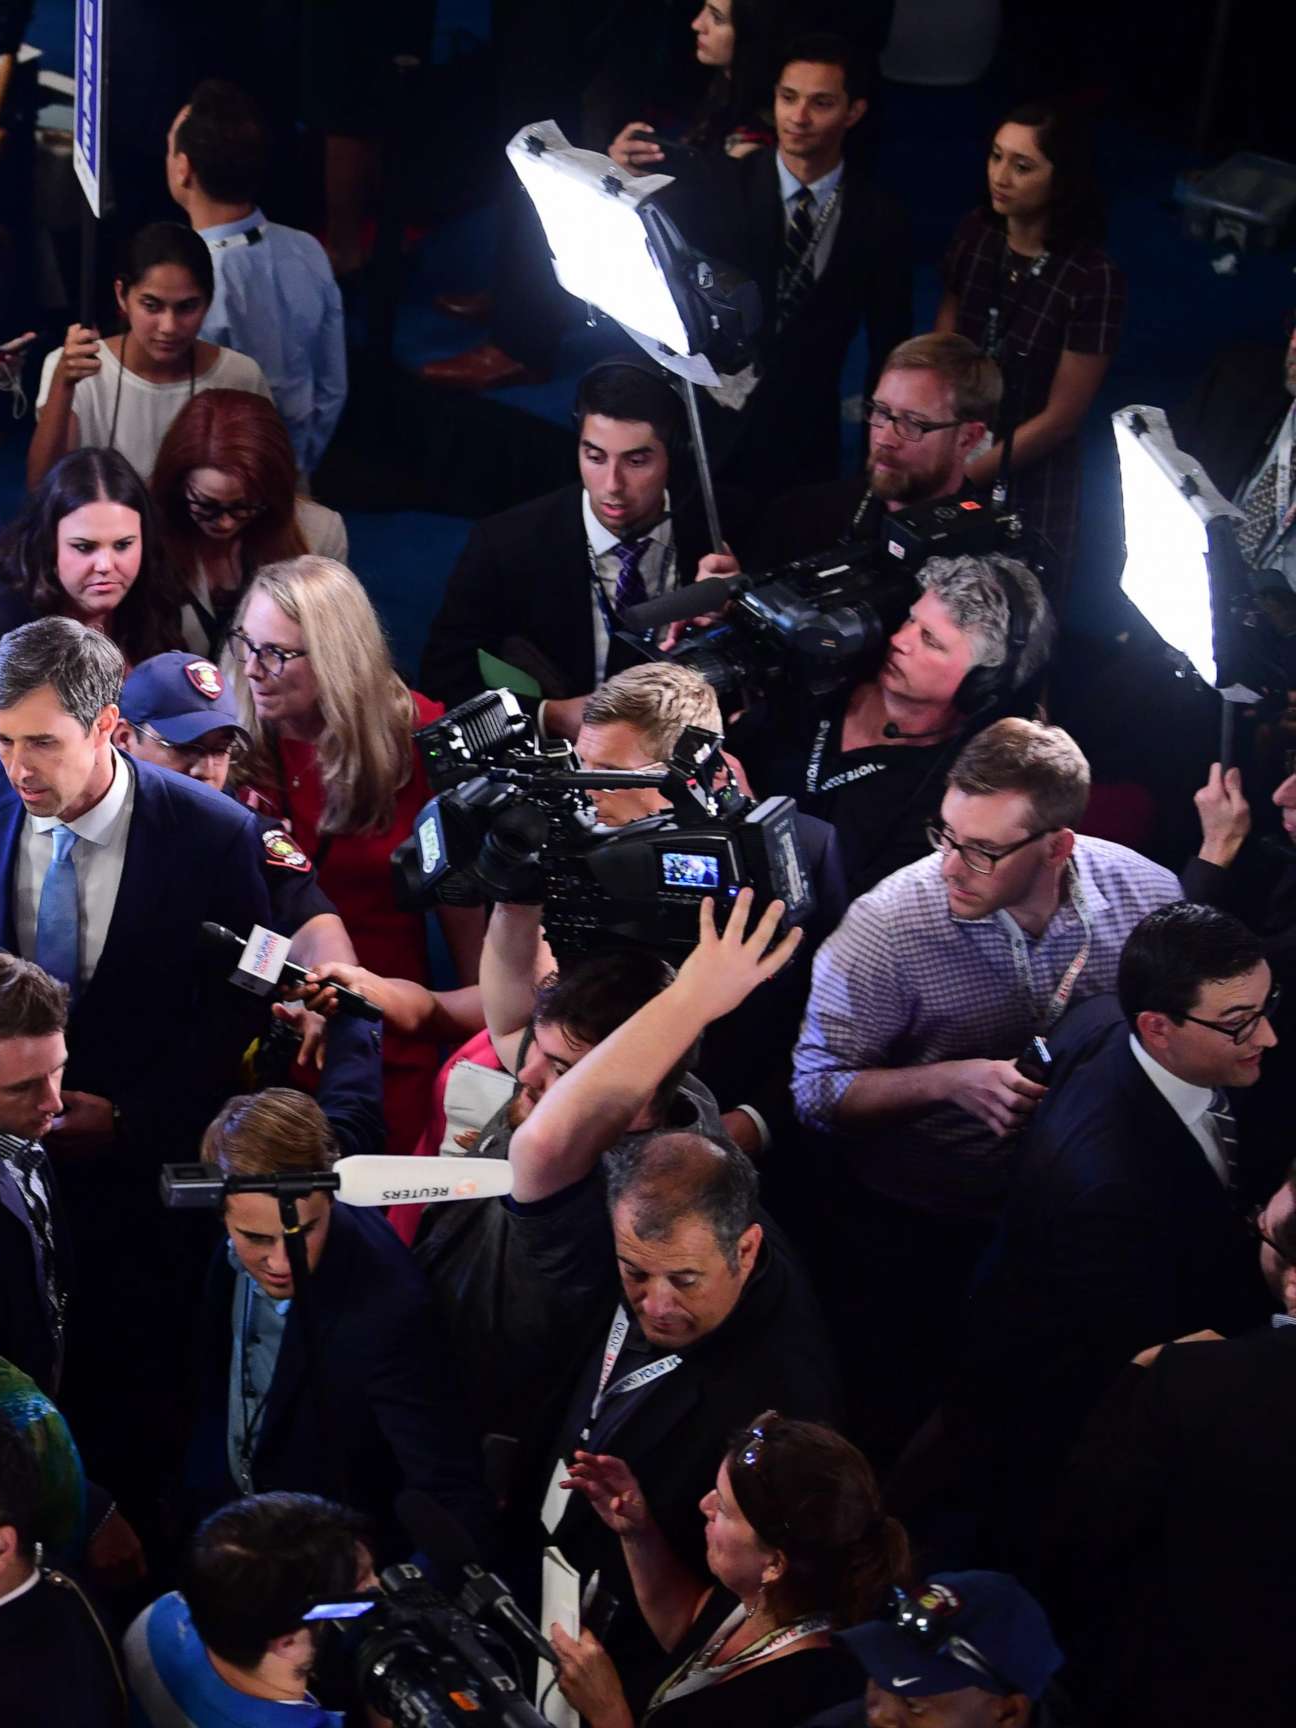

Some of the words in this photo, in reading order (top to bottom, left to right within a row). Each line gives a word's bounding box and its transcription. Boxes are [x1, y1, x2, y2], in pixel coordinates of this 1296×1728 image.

[845, 762, 878, 783] VOTE
[381, 1186, 450, 1201] REUTERS
[607, 1321, 625, 1351] 2020
[637, 1360, 666, 1381] YOUR
[767, 1626, 798, 1649] VOTE
